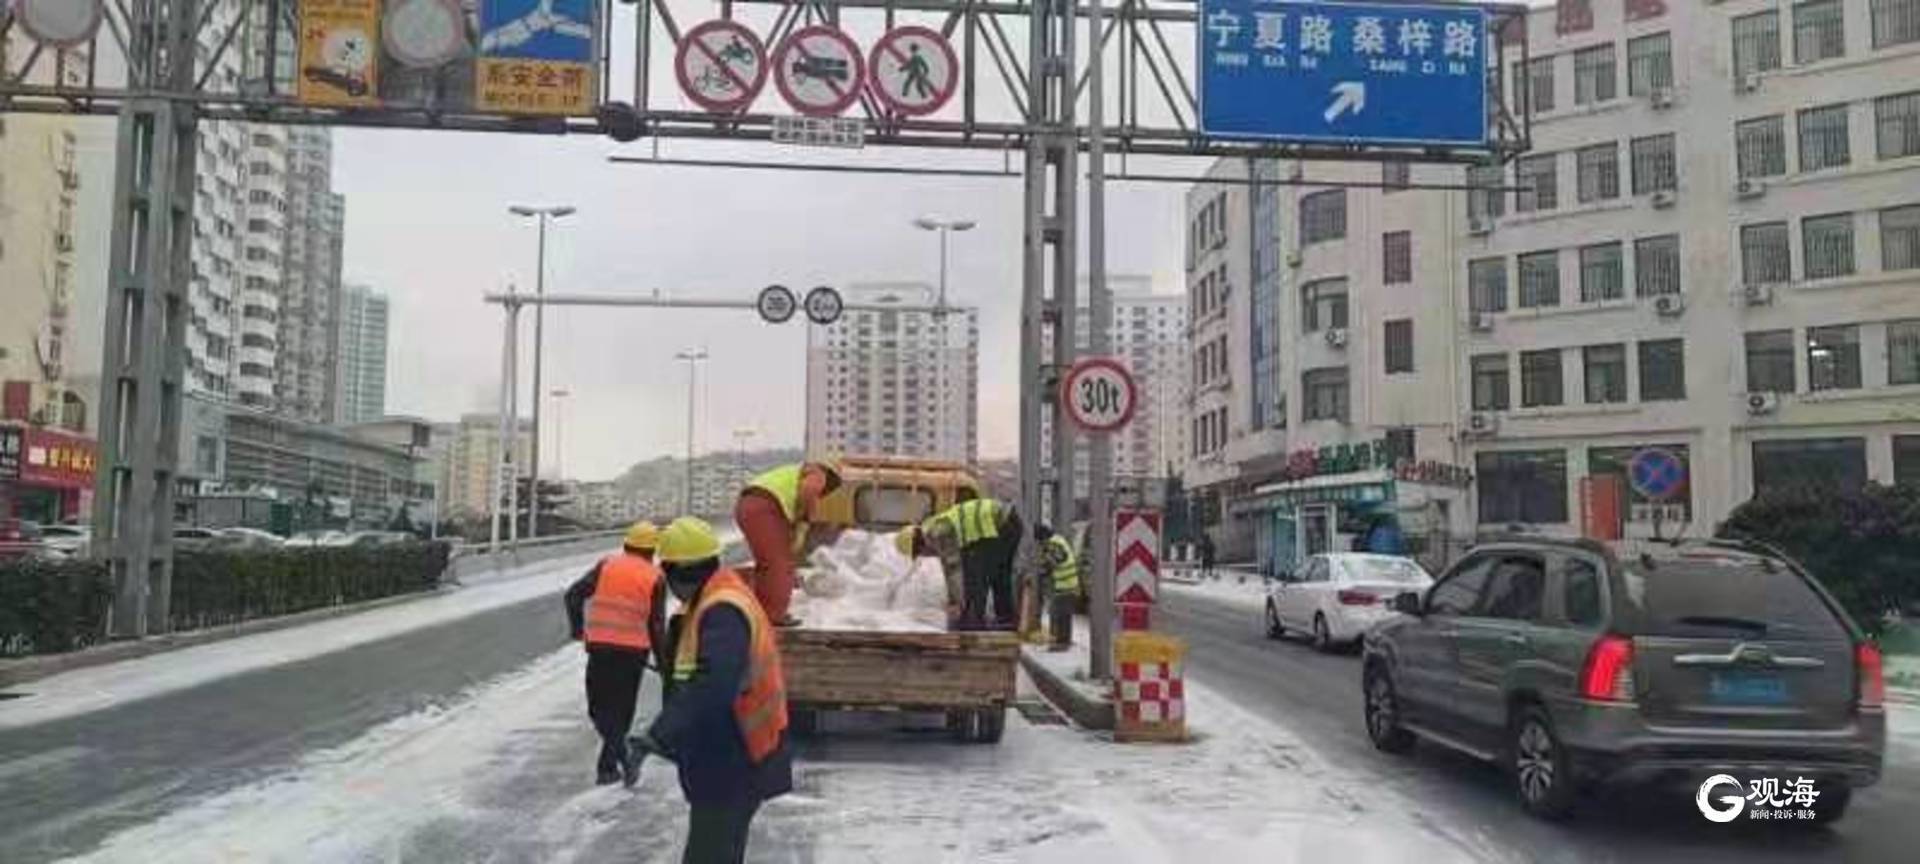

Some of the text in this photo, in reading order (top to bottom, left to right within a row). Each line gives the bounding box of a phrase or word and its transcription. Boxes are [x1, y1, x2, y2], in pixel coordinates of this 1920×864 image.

[1208, 9, 1477, 58] 宁夏路 桑梓路
[1082, 377, 1119, 414] 30t
